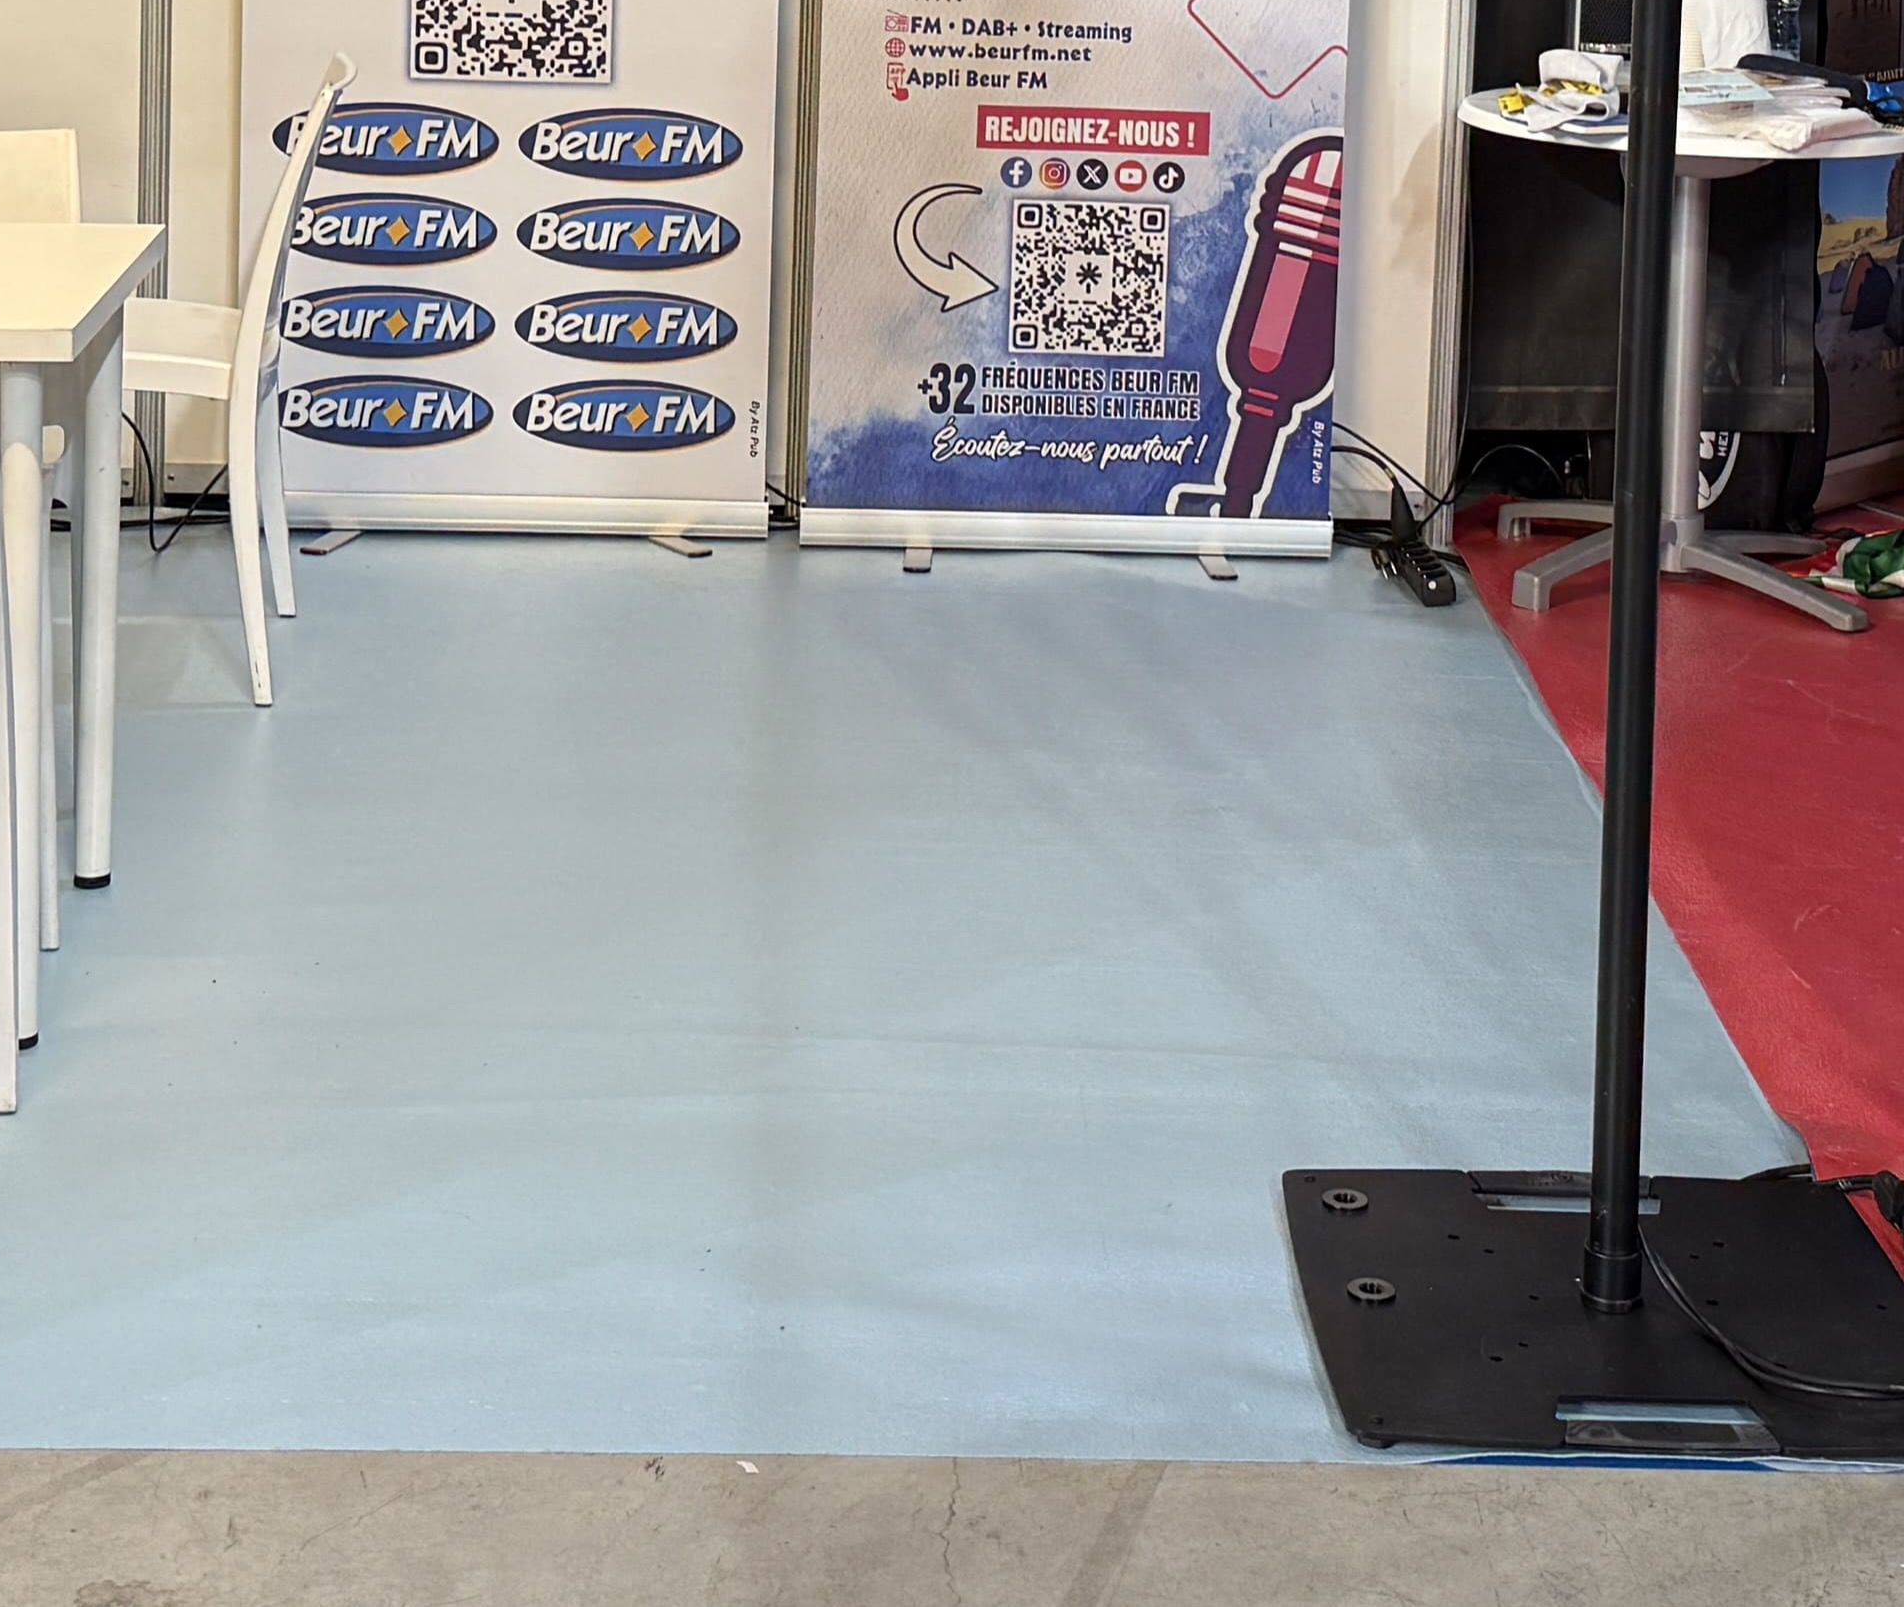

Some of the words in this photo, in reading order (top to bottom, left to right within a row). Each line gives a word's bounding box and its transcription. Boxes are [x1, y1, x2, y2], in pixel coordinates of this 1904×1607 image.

[910, 16, 942, 34] FM
[961, 18, 1017, 36] DAB+
[1037, 20, 1132, 43] Streaming
[909, 42, 1091, 63] www.beurfm.net
[906, 67, 960, 89] Appli
[966, 70, 1010, 87] Beur
[1017, 71, 1047, 89] FM
[416, 119, 479, 159] FM
[532, 122, 634, 163] Beur
[660, 125, 723, 165] FM
[985, 115, 1180, 148] REJOIGNEZ-NOUS
[413, 209, 478, 249] FM
[530, 211, 631, 253] Beur
[657, 215, 720, 255] FM
[283, 298, 386, 339] Beur
[411, 302, 476, 342] FM
[528, 305, 630, 345] Beur
[655, 308, 718, 348] FM
[981, 361, 1103, 393] FRÉQUENCES
[1110, 369, 1163, 393] BEUR
[1168, 372, 1200, 395] FM
[281, 389, 384, 429] Beur
[410, 392, 474, 432] FM
[526, 394, 627, 434] Beur
[653, 396, 717, 436] FM
[749, 400, 760, 415] By
[981, 395, 1097, 418] DISPONIBLES
[1102, 397, 1126, 419] EN
[1130, 398, 1200, 420] FRANCE
[932, 417, 1096, 463] Écoutez-nous
[1099, 433, 1190, 468] partout
[1311, 420, 1325, 438] By
[1312, 460, 1323, 484] Pub
